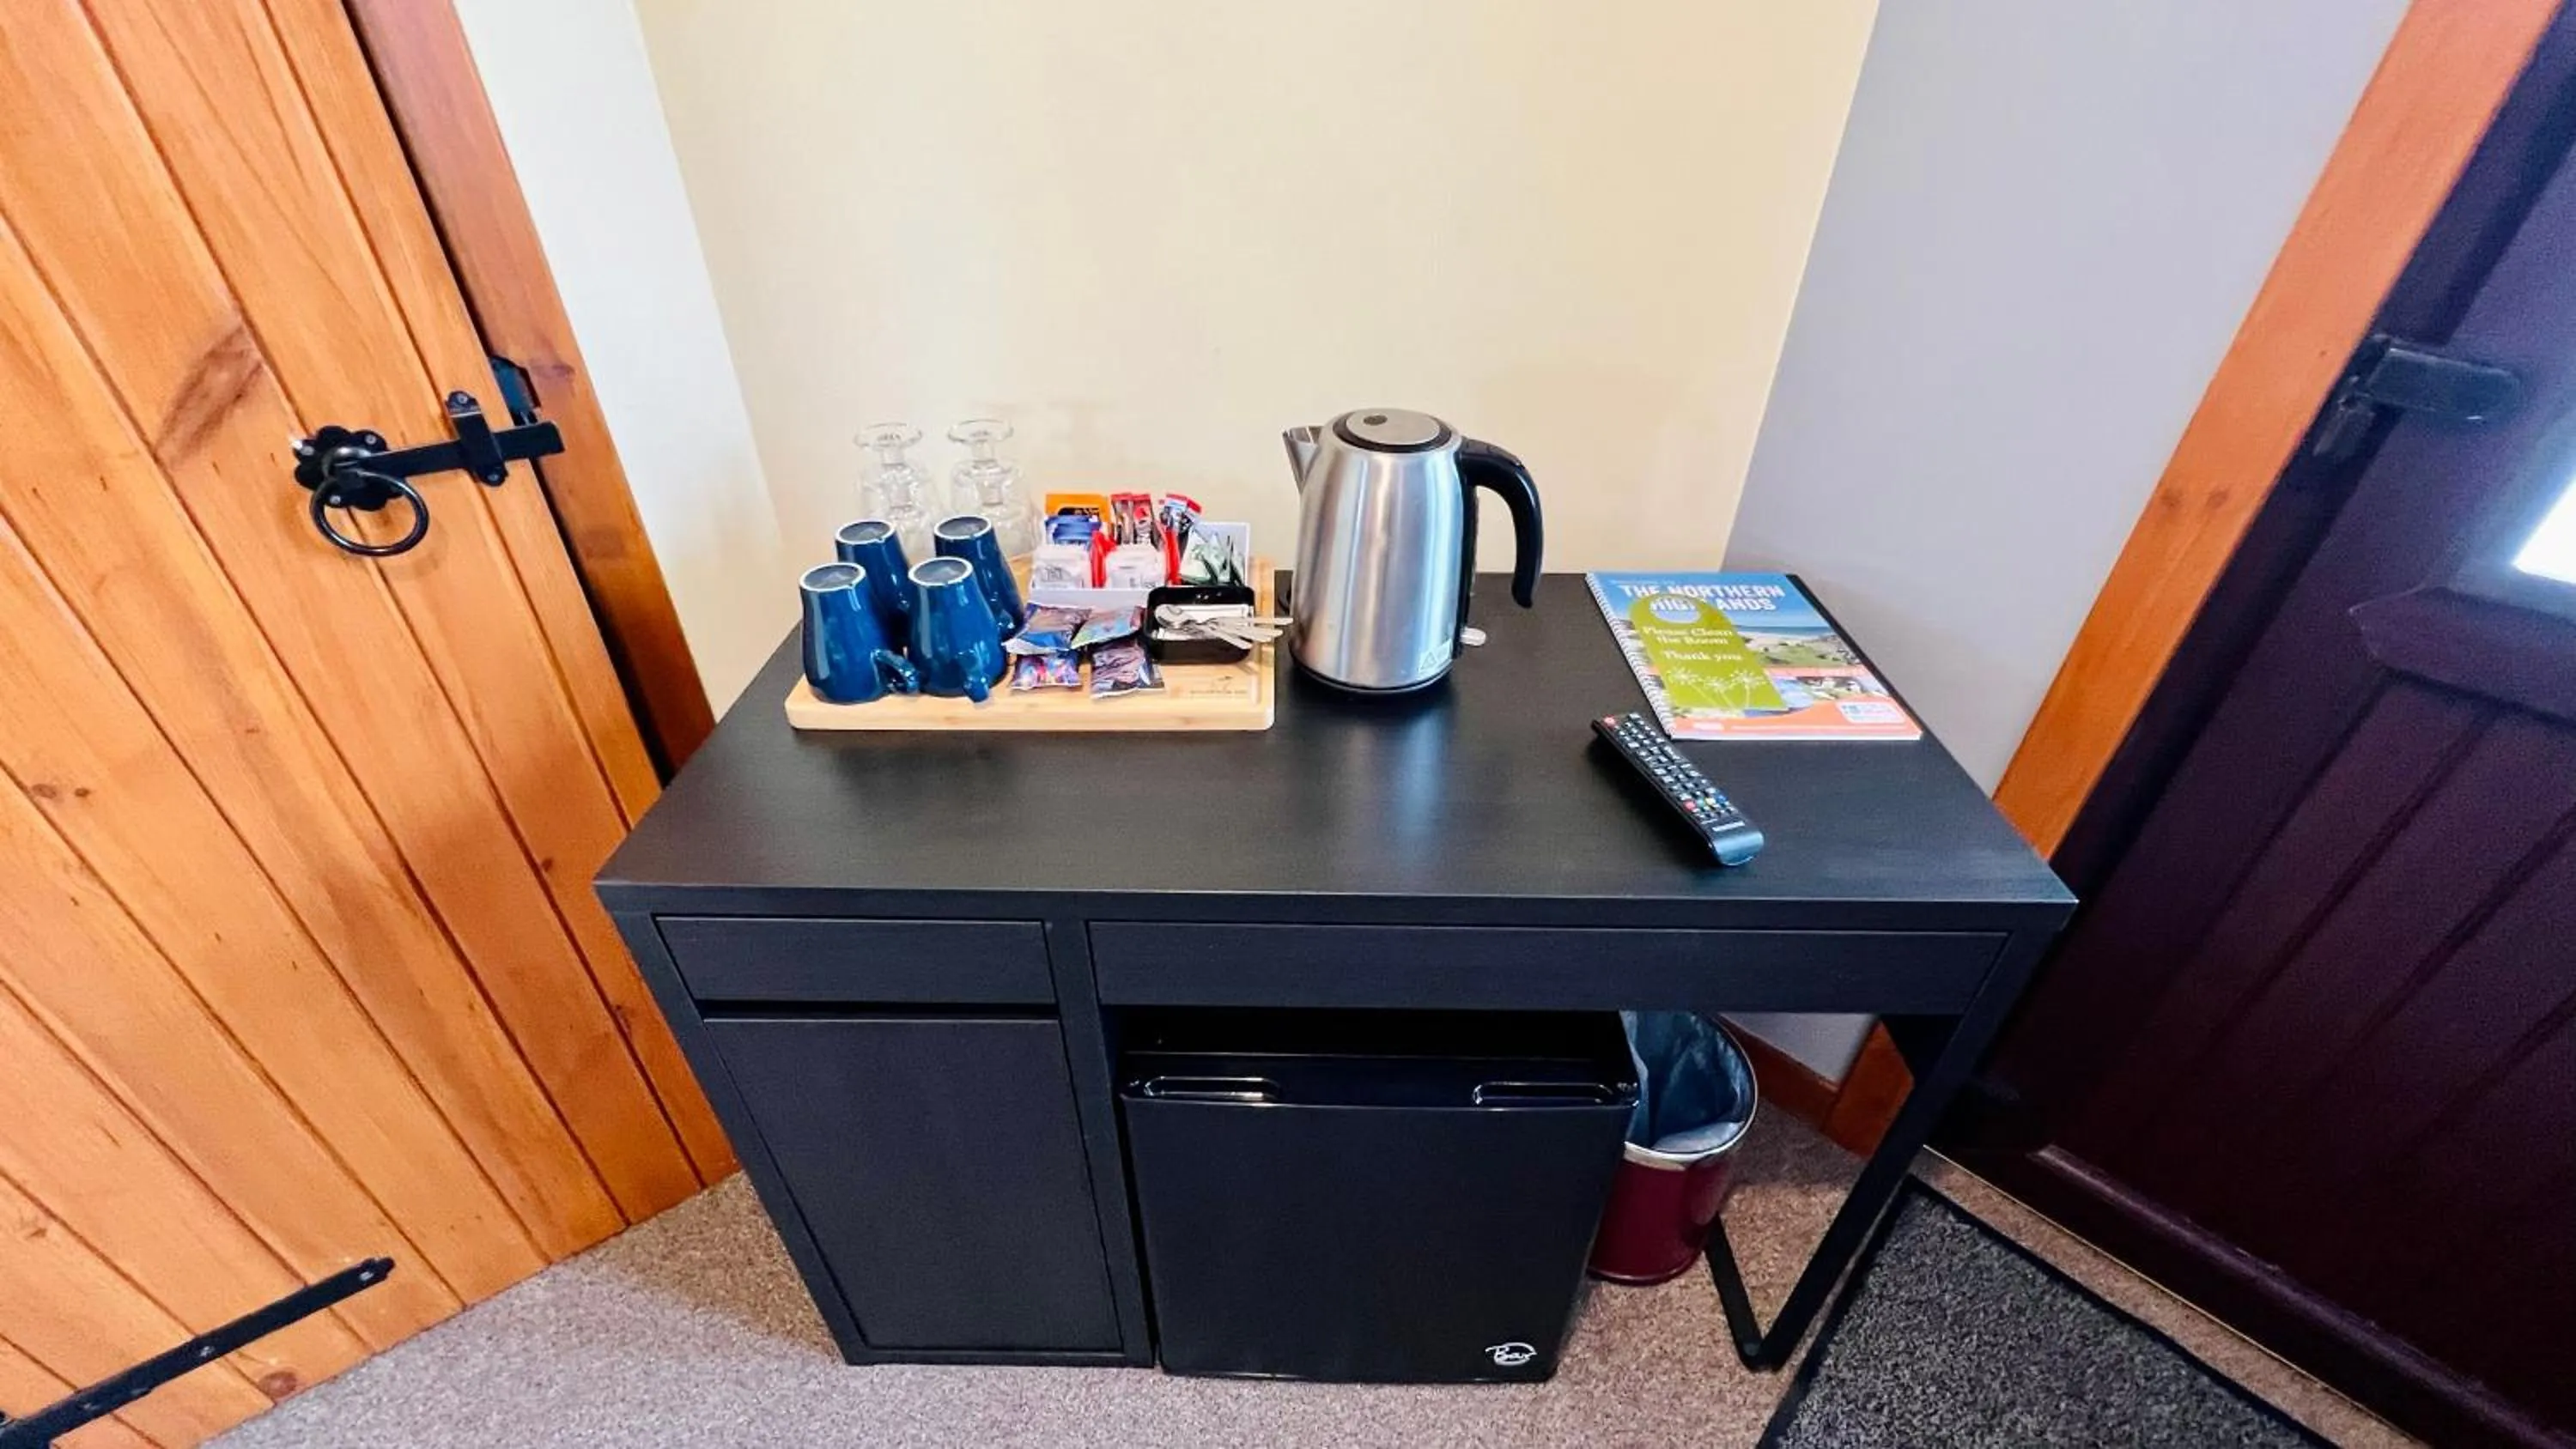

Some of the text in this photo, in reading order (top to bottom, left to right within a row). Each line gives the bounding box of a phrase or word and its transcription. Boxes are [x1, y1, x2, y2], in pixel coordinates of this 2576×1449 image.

[1618, 584, 1786, 598] THE NORTHERN
[1642, 626, 1733, 637] Please Clean
[1656, 635, 1729, 645] the Room
[1663, 651, 1743, 663] Thank you
